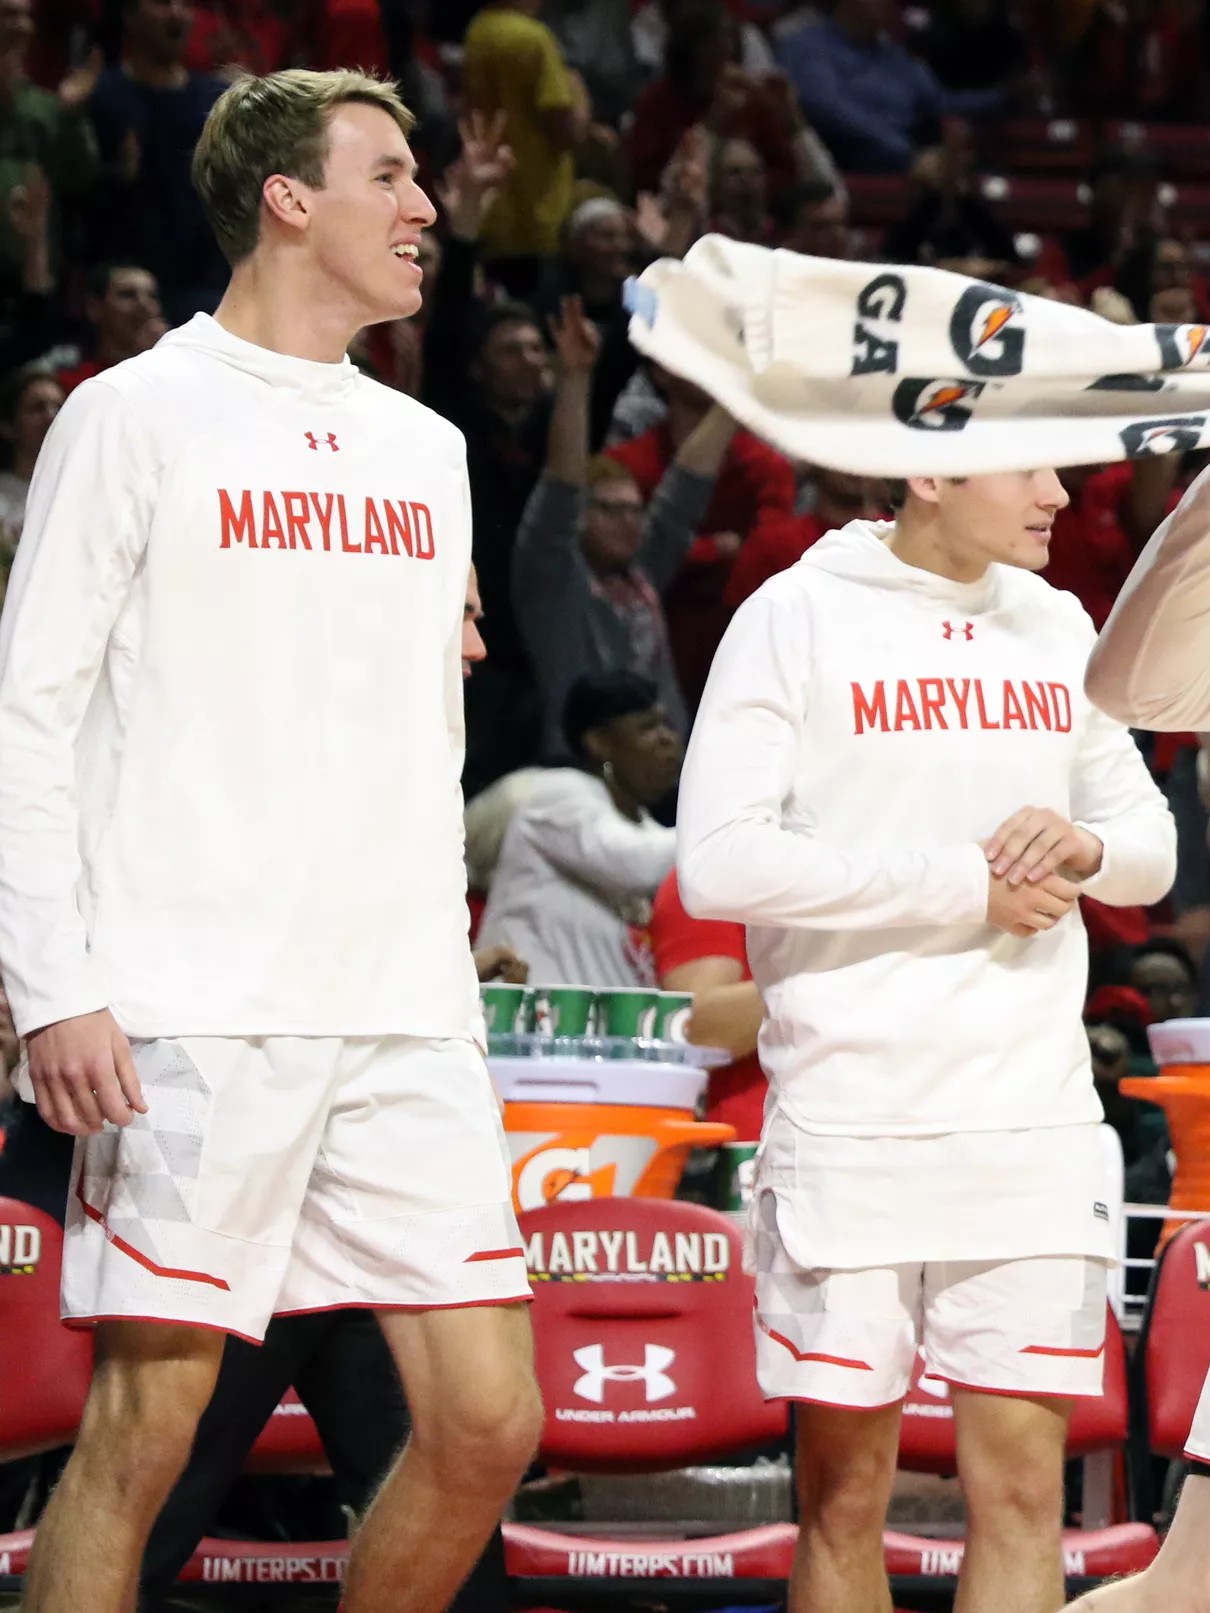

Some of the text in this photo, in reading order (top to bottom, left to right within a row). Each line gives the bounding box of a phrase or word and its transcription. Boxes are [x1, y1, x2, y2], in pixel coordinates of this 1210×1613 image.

[216, 488, 436, 561] MARYLAND
[850, 677, 1073, 735] MARYLAND
[526, 1230, 731, 1273] MARYLAND
[556, 1407, 696, 1422] UNDER ARMOUR
[568, 1552, 734, 1577] UMTERPS.COM
